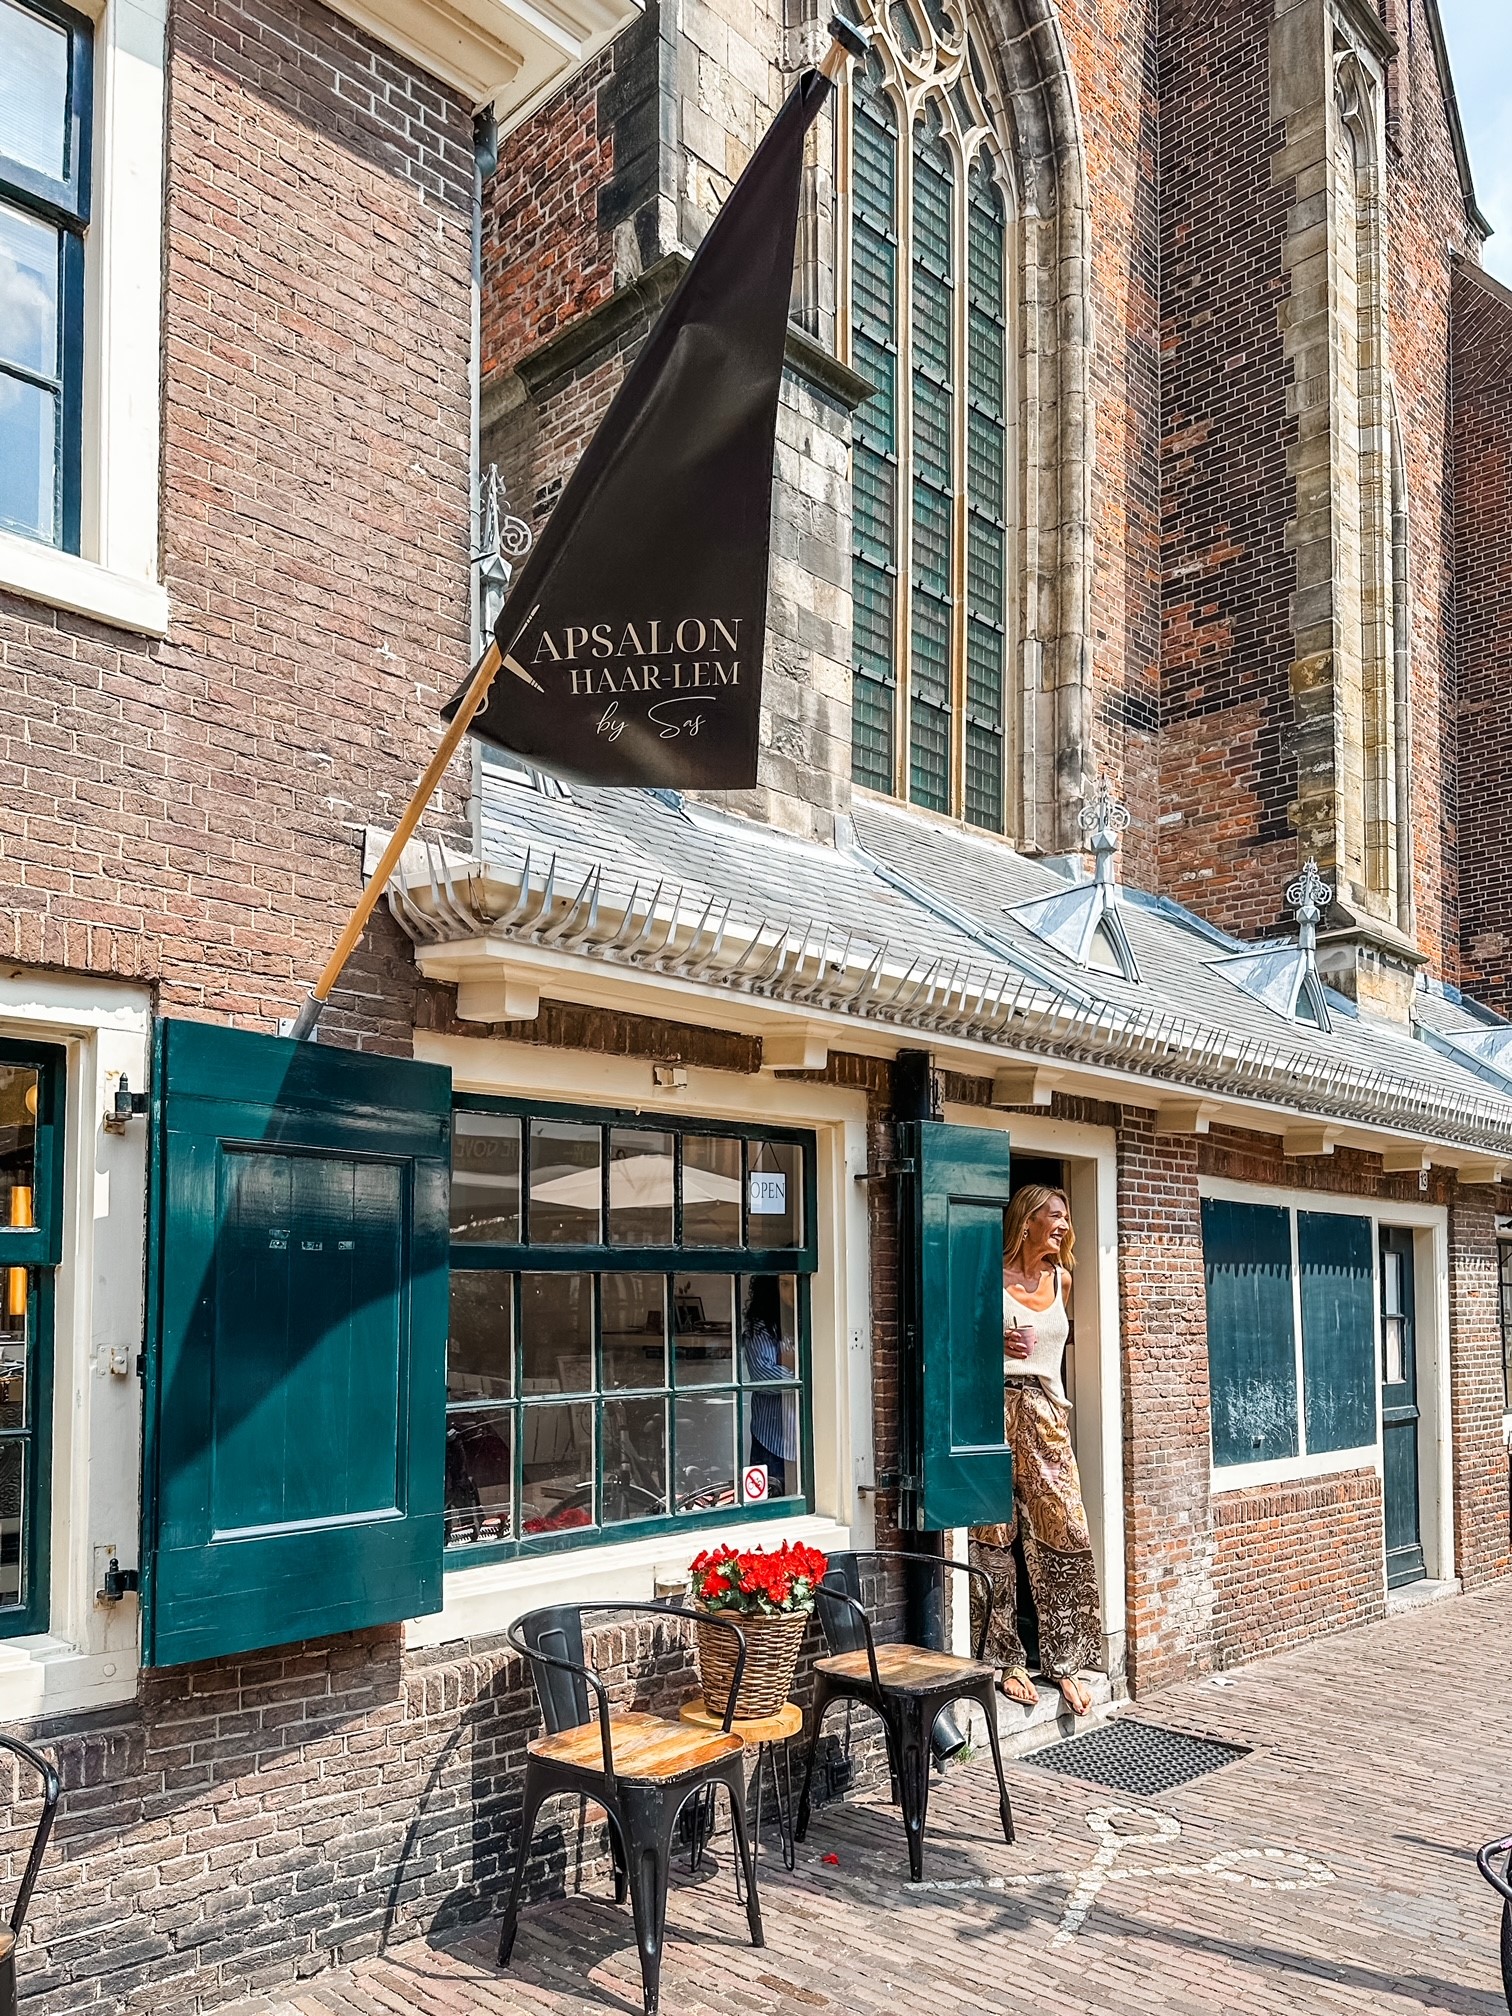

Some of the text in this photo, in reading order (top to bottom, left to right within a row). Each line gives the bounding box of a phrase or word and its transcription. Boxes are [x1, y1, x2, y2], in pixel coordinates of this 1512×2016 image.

[569, 661, 741, 695] HAAR-LEM
[596, 696, 716, 742] by Sas
[751, 1181, 785, 1199] OPEN
